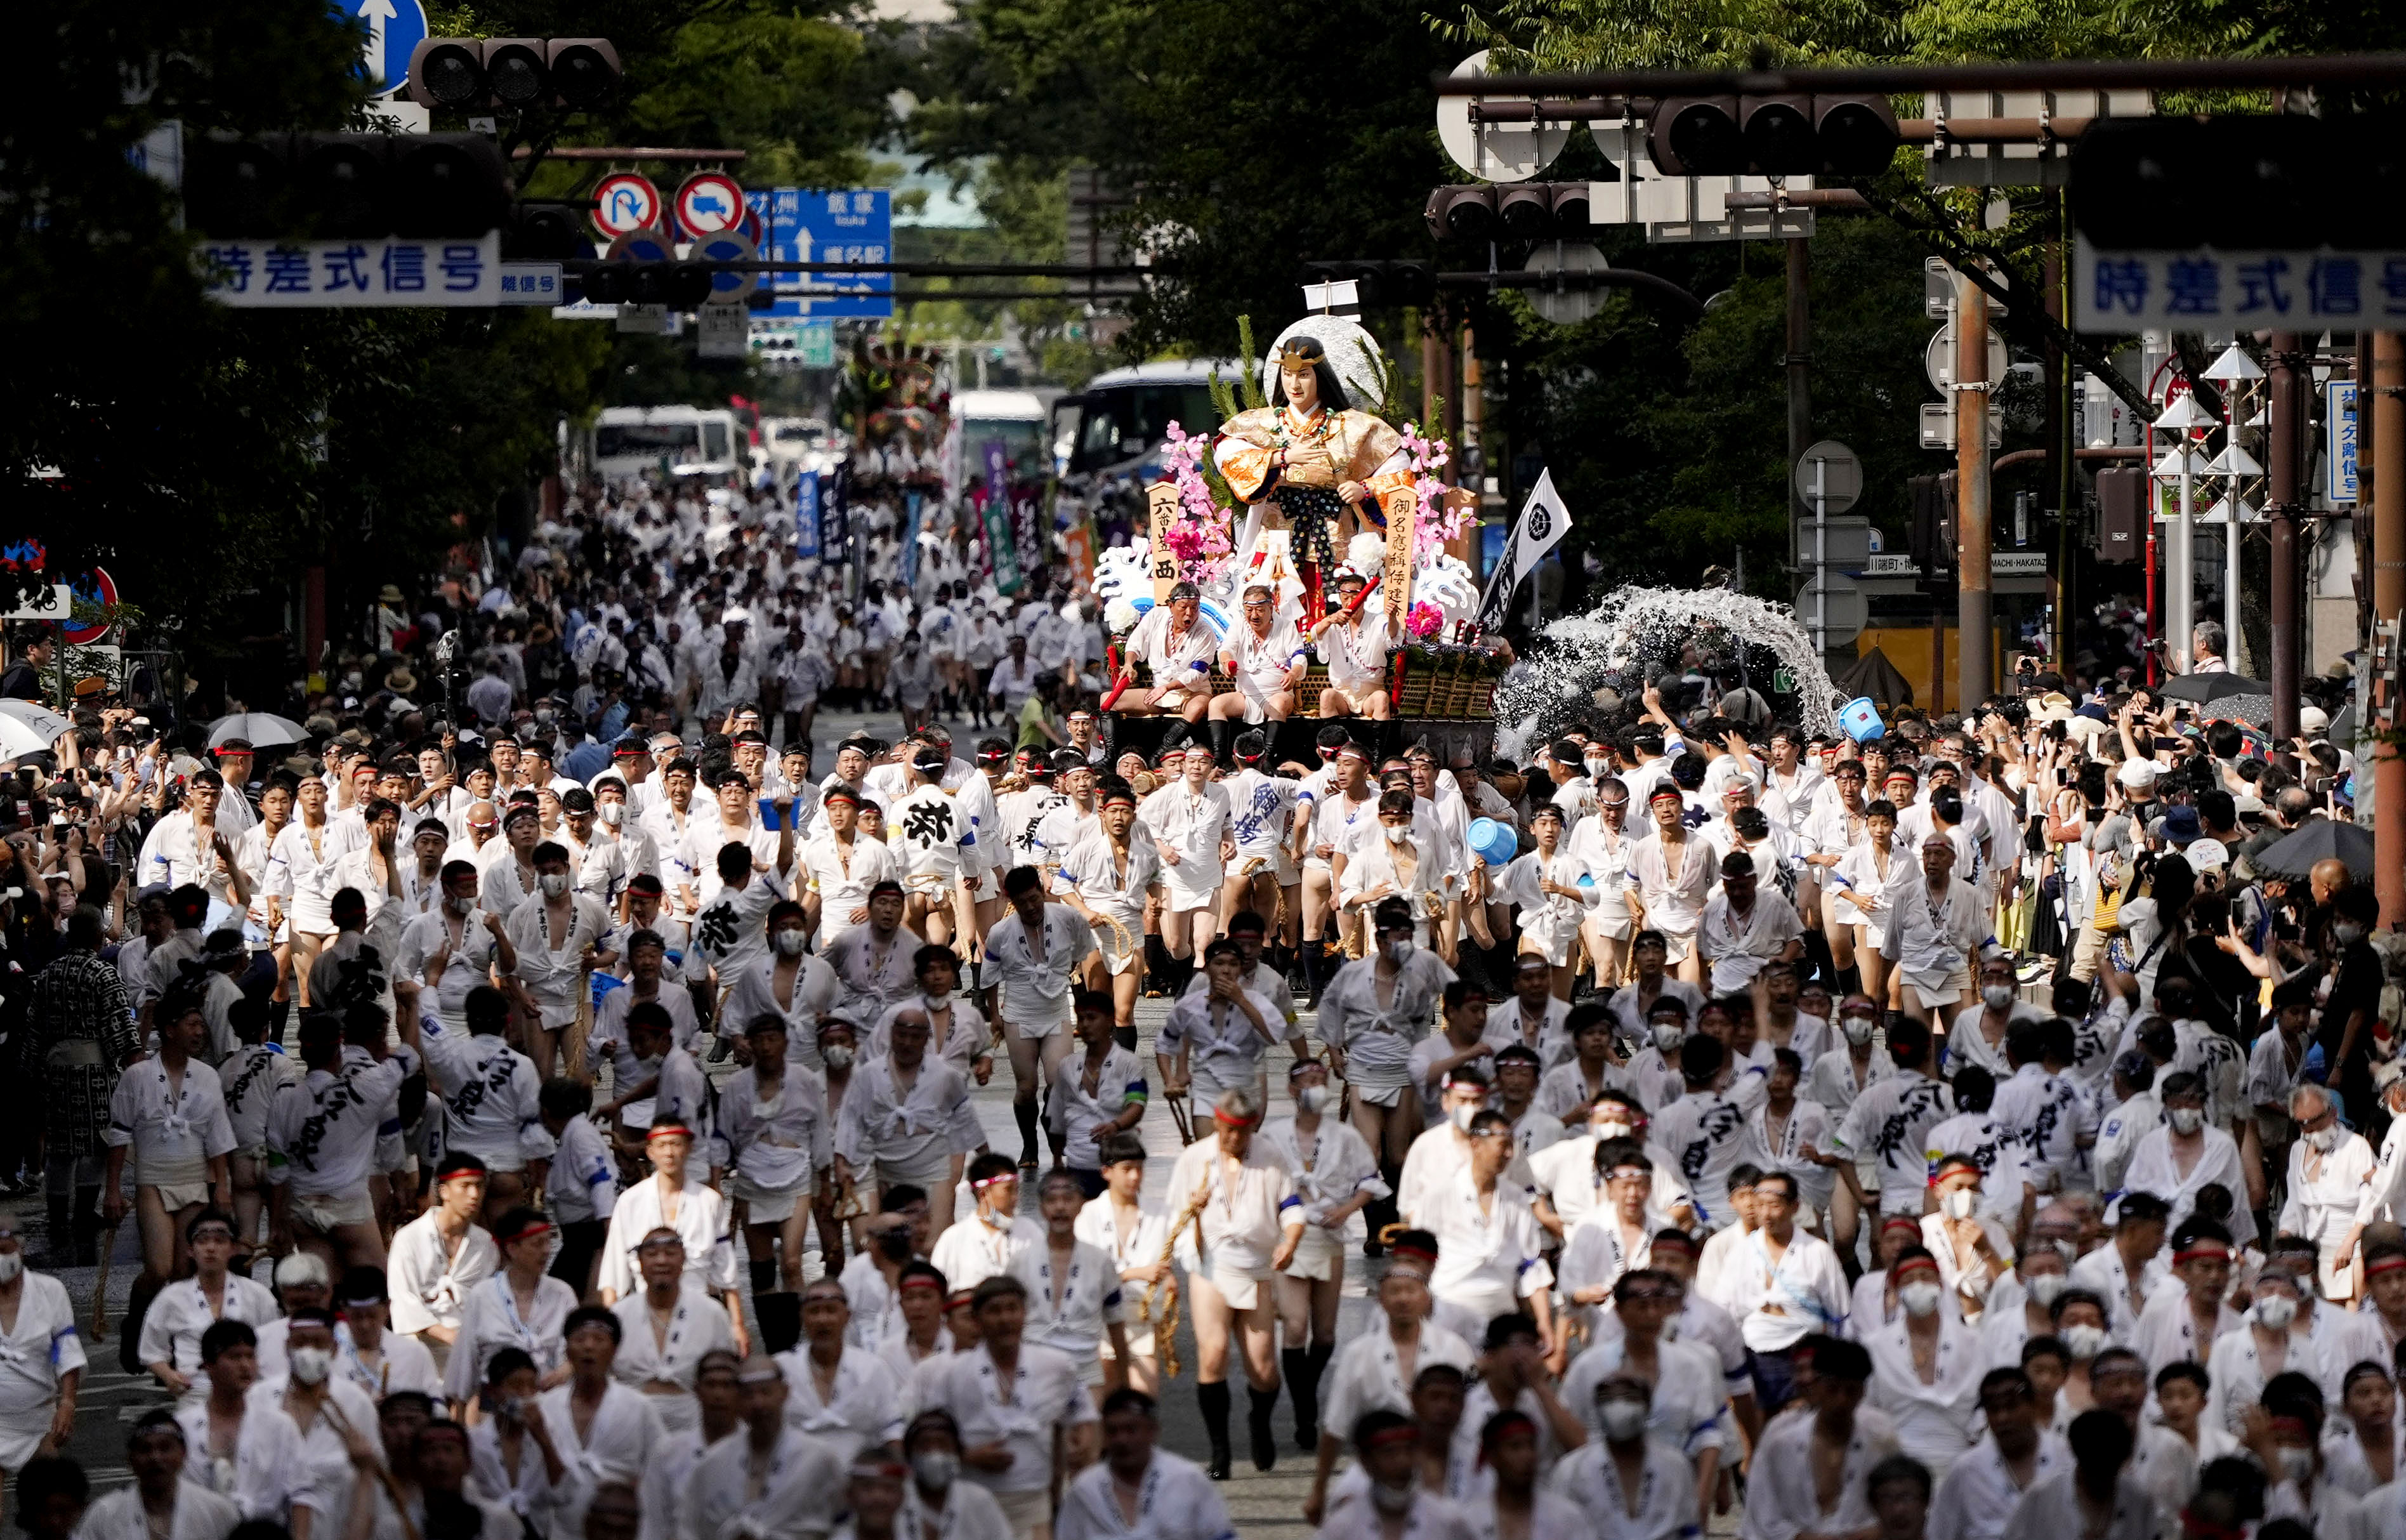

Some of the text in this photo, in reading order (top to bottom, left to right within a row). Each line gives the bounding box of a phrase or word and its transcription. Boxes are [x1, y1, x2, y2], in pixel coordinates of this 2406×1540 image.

[206, 245, 484, 294] 時差式信号
[1875, 1079, 1944, 1169] 冷泉
